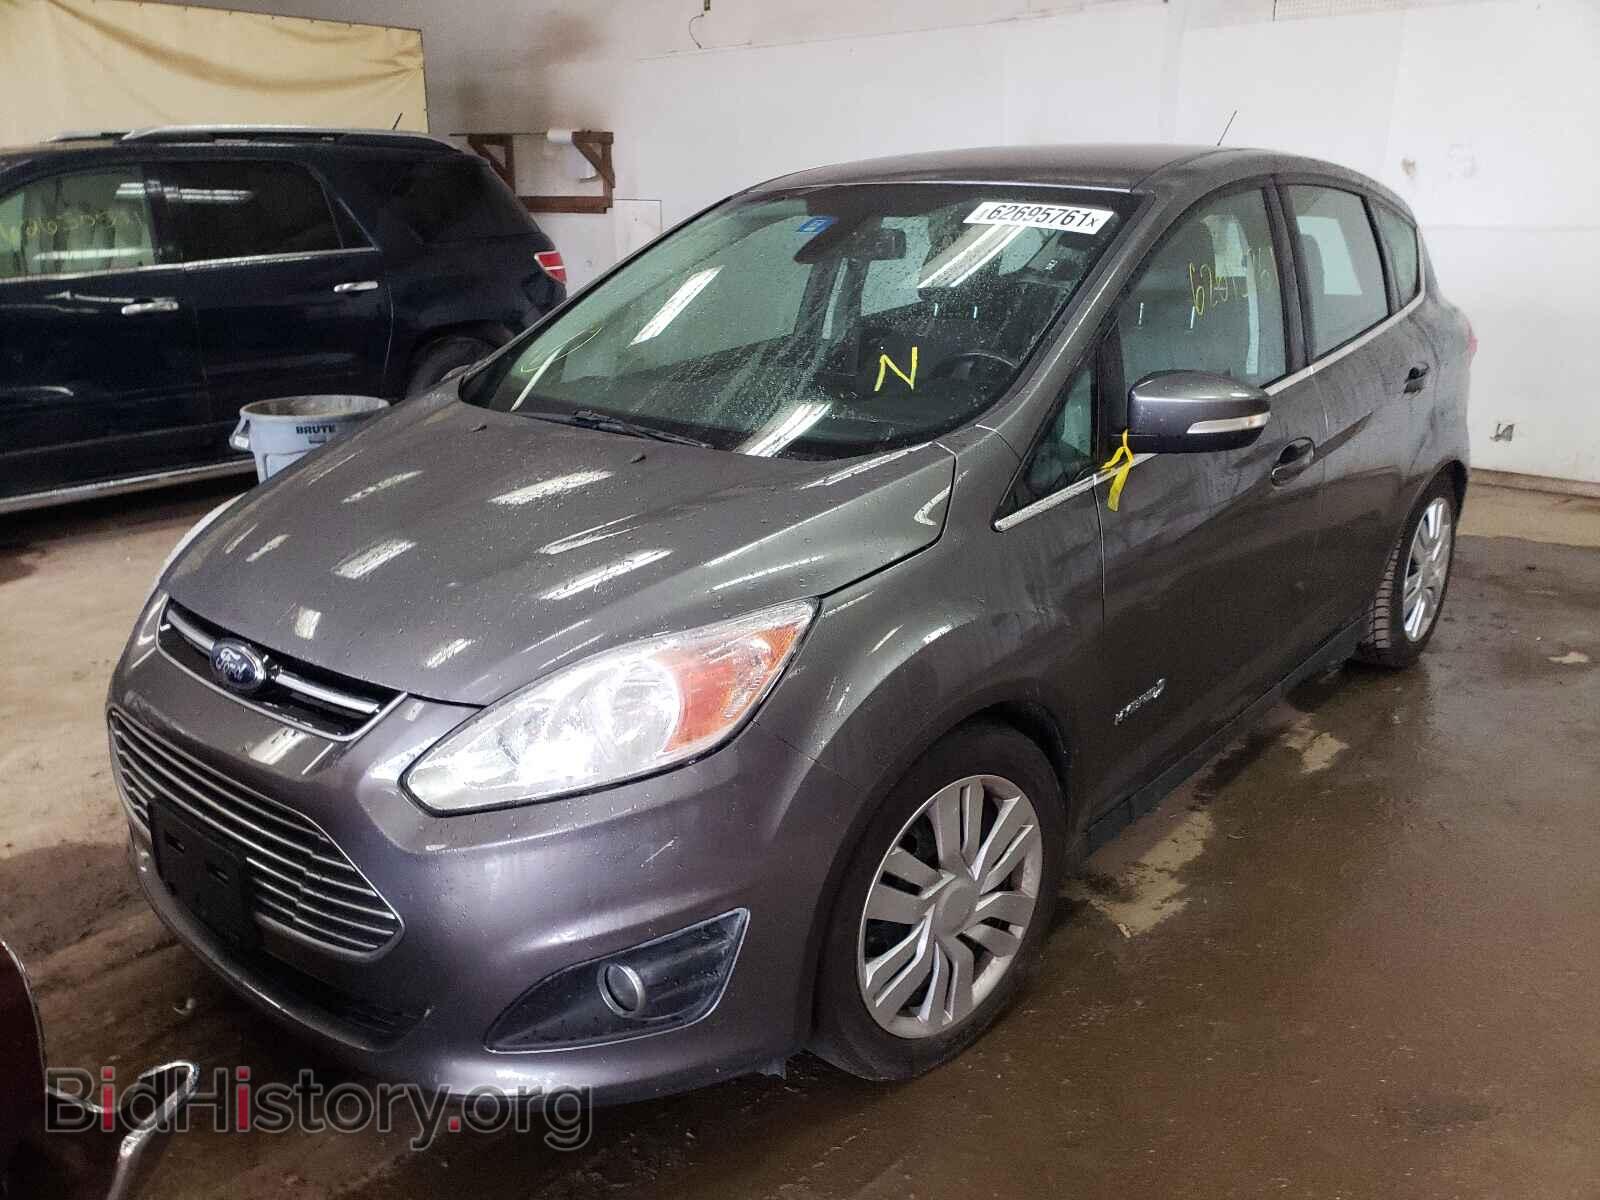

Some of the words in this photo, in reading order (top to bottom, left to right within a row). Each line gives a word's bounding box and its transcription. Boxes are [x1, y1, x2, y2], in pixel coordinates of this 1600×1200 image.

[874, 346, 918, 392] N
[295, 424, 336, 435] BRUTE
[215, 647, 247, 681] Ford
